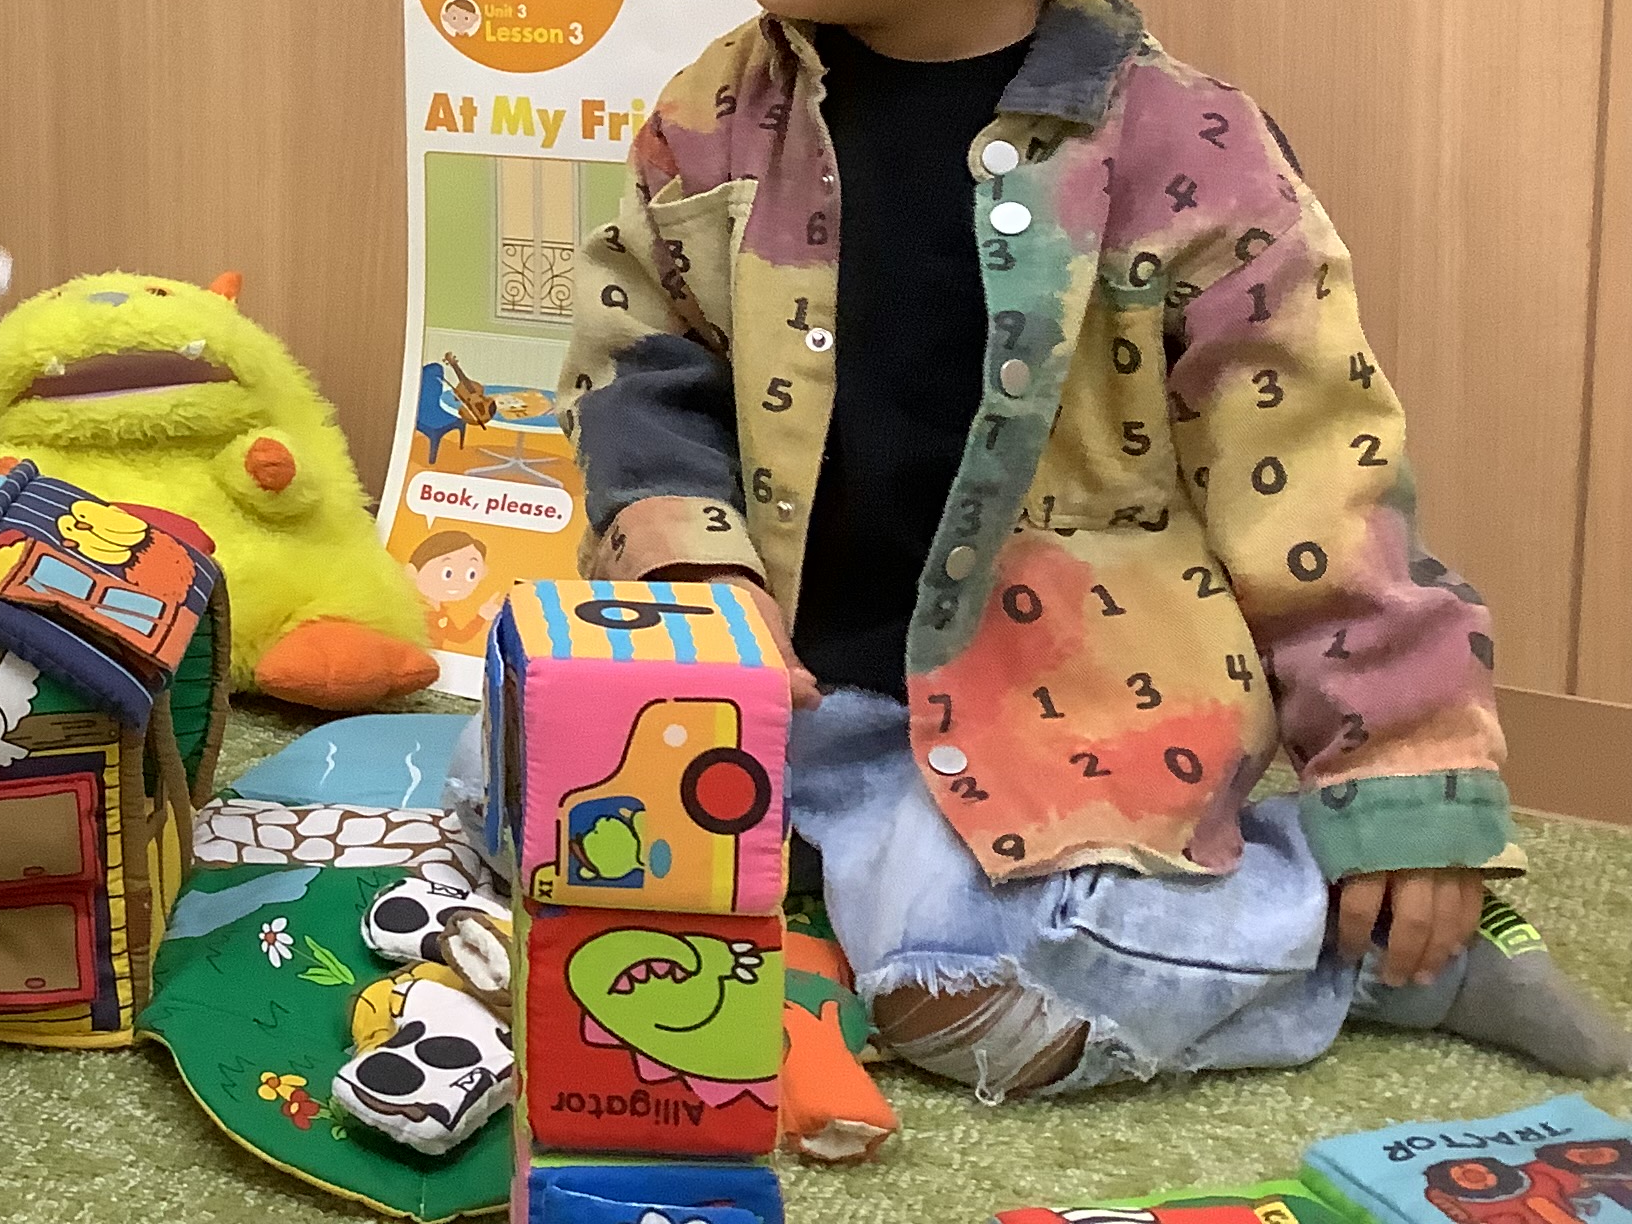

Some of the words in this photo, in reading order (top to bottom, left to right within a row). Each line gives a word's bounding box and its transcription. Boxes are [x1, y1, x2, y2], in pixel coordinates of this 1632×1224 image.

[484, 4, 513, 18] Unit
[517, 4, 528, 18] 3
[484, 21, 564, 44] Lesson
[568, 22, 584, 45] 3
[715, 84, 737, 119] 5
[424, 92, 478, 134] At
[490, 95, 566, 149] My
[1198, 112, 1229, 150] 2
[1164, 173, 1197, 213] 4
[806, 211, 829, 245] 6
[982, 238, 1017, 271] 3
[786, 297, 809, 331] 1
[1246, 283, 1272, 323] 1
[1112, 337, 1143, 374] 0
[1348, 351, 1377, 390] 4
[761, 377, 793, 413] 5
[1251, 369, 1285, 410] 3
[1121, 421, 1152, 456] 5
[1349, 433, 1388, 467] 2
[752, 467, 773, 504] 6
[1250, 456, 1288, 495] 0
[419, 484, 479, 510] Book,
[485, 493, 563, 520] please.
[703, 506, 732, 532] 3
[1286, 541, 1328, 582] 0
[1090, 584, 1127, 617] 1
[1181, 566, 1226, 599] 2
[1001, 583, 1043, 624] 0
[1126, 672, 1163, 710] 3
[1225, 654, 1253, 693] 4
[928, 693, 953, 733] 7
[1032, 687, 1065, 720] 1
[1069, 752, 1112, 778] 2
[1164, 746, 1204, 785] 0
[550, 1088, 705, 1127] Alligator
[1382, 1121, 1574, 1162] TRACTOR
